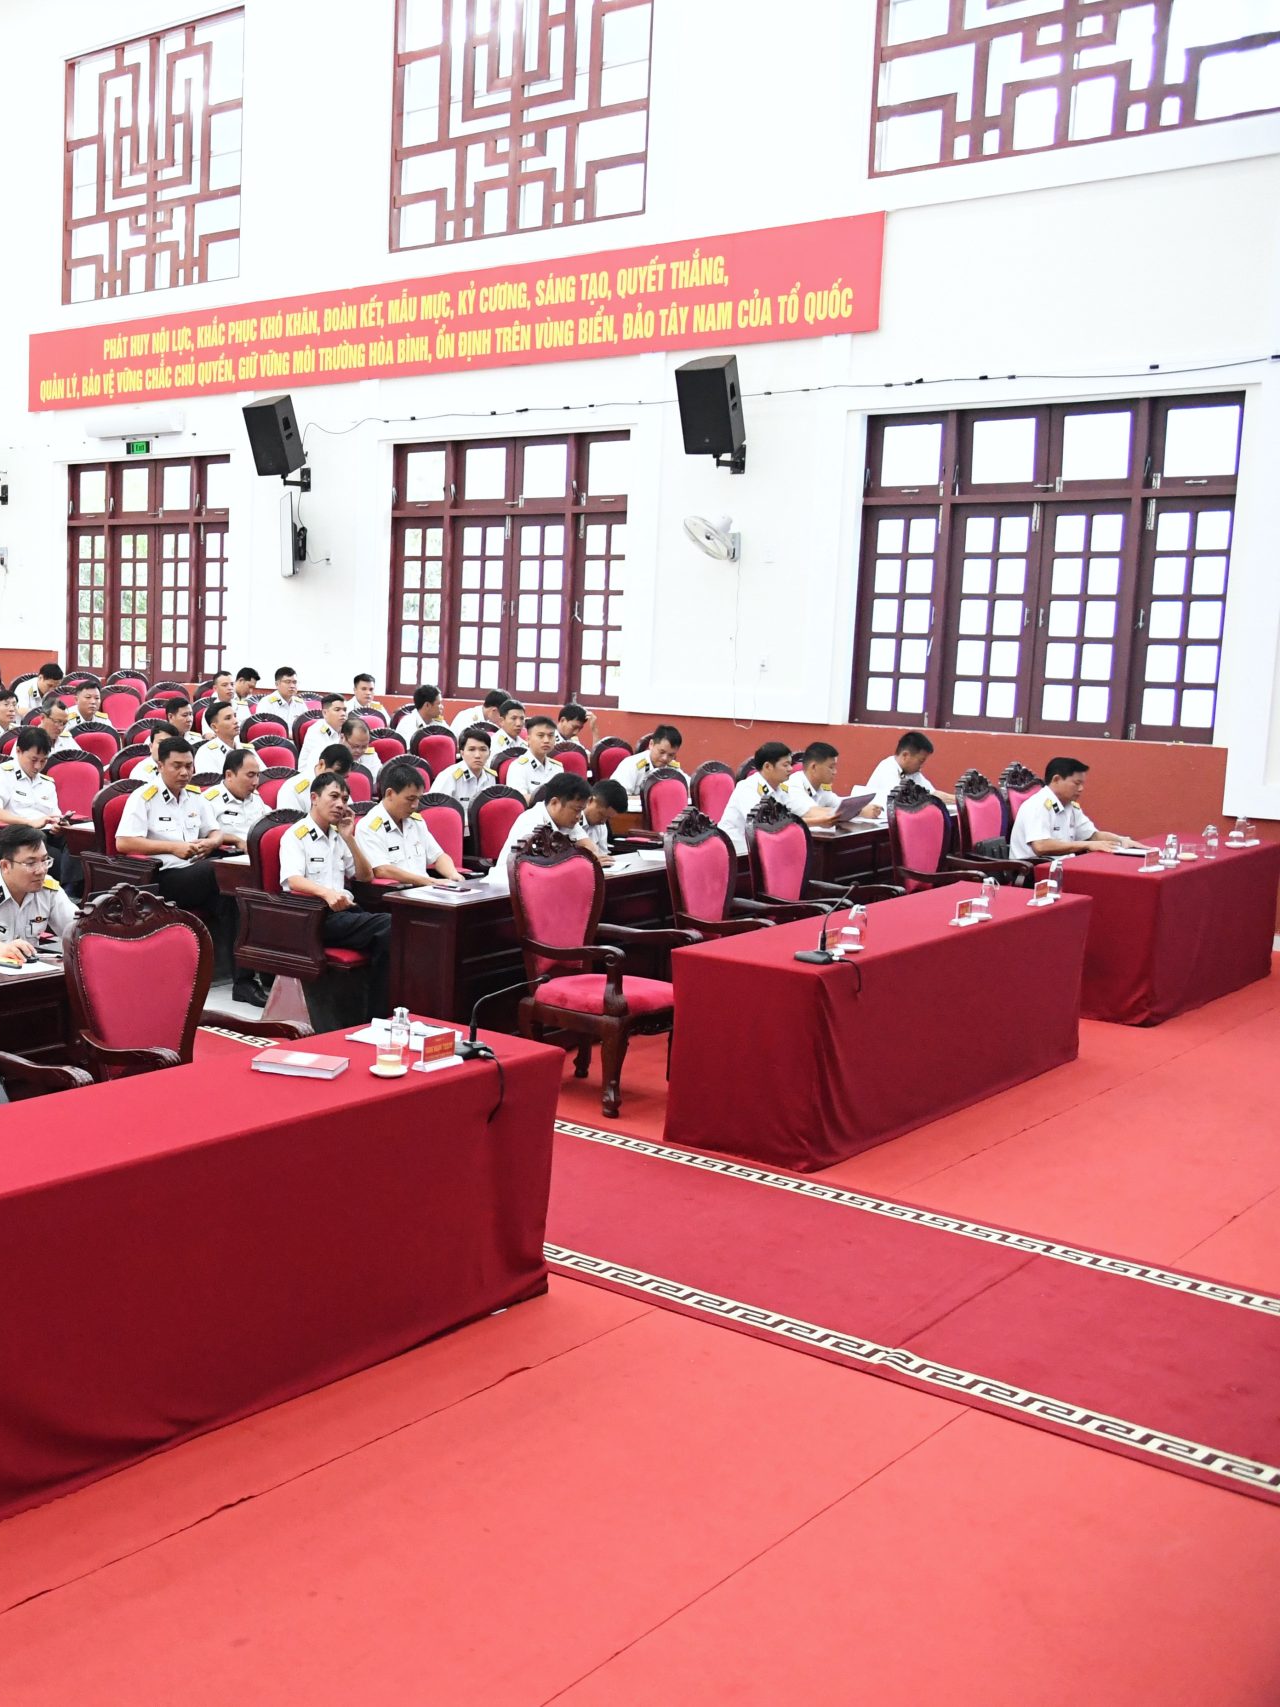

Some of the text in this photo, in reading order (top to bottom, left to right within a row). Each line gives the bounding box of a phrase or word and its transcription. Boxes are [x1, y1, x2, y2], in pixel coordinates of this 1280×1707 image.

[66, 372, 80, 400] LÝ,
[82, 368, 101, 397] BẢO
[103, 368, 115, 399] VỆ
[117, 367, 143, 393] VỮNG
[175, 356, 196, 387] CHỦ
[238, 351, 258, 380] GIỮ
[260, 349, 290, 377] VỮNG
[293, 344, 315, 374] MÔI
[318, 339, 366, 371] TRƯỜNG
[369, 335, 394, 366] HÒA
[397, 332, 432, 363] BÌNH,
[435, 323, 455, 359] ỔN
[458, 328, 491, 362] ĐỊNH
[495, 319, 531, 353] TRÊN
[535, 316, 574, 349] VÙNG
[578, 304, 618, 344] BIỂN,
[622, 302, 655, 340] ĐẢO
[659, 301, 689, 336] TÂY
[693, 301, 733, 333] NAM
[737, 288, 772, 329] CỦA
[777, 281, 801, 325] TỔ
[804, 277, 853, 325] QUỐC
[104, 248, 729, 360] PHÁT HUY NỘI LỰC, KHẮC PHỤC KHÓ KHĂN, ĐOÀN KẾT, MẪU MỰC, KỶ CƯƠNG, SÁNG TẠO, QUYẾT THẮNG,
